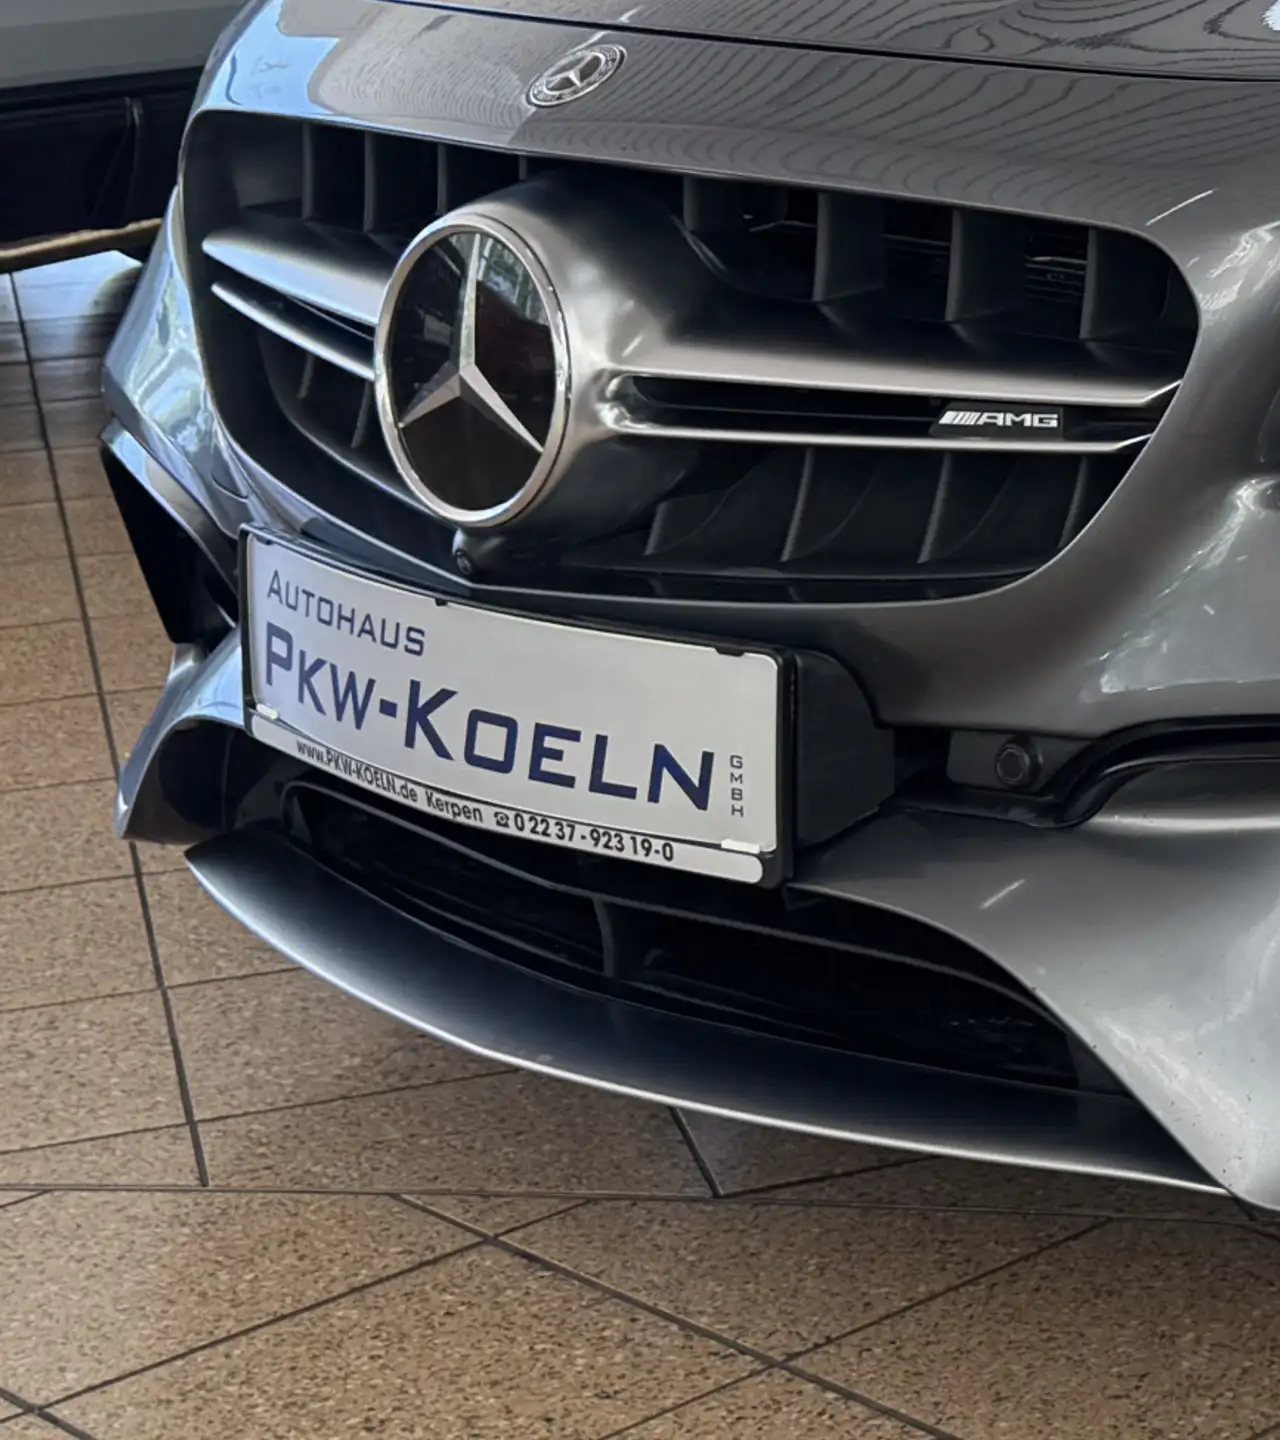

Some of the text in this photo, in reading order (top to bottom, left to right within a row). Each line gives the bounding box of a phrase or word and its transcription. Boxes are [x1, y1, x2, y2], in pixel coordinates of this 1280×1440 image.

[266, 569, 426, 657] AUTOHAUS
[264, 621, 715, 813] PKW-KOELN
[295, 740, 419, 803] www.PKW-KOELN.de
[425, 788, 484, 822] Kerpen
